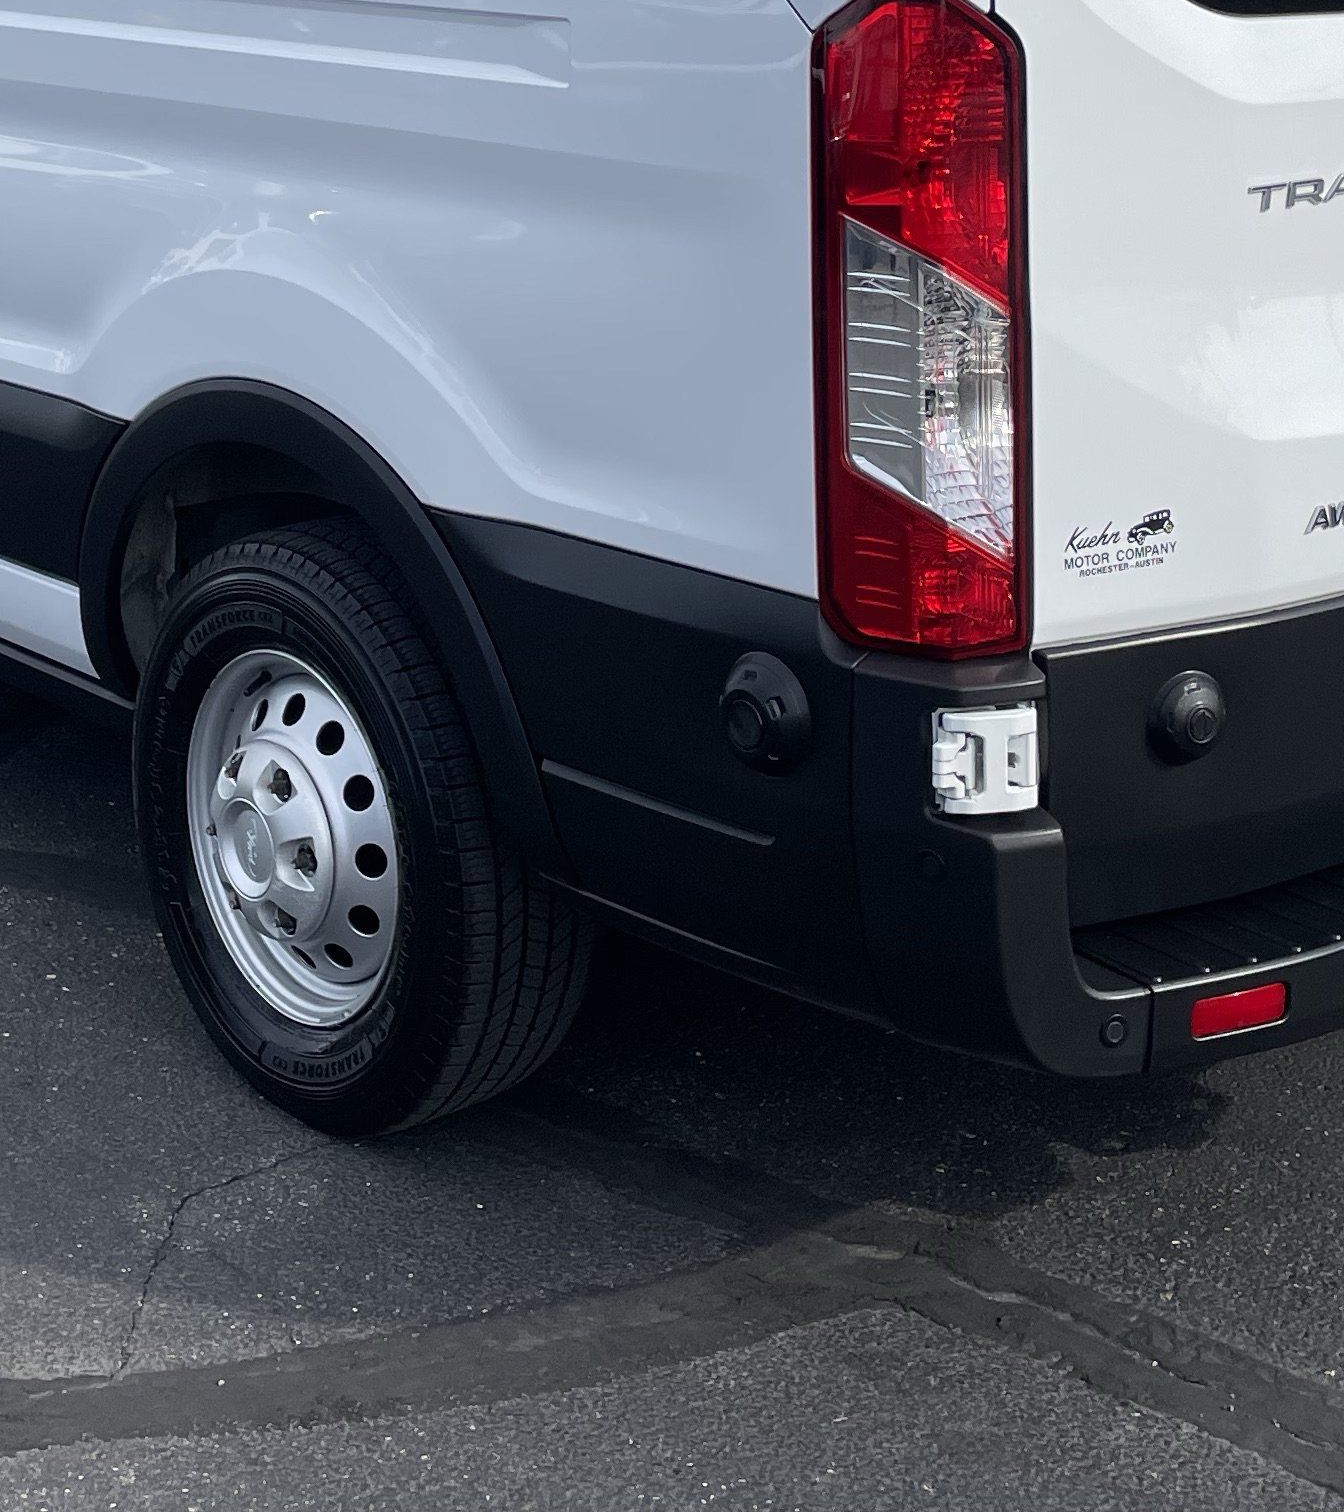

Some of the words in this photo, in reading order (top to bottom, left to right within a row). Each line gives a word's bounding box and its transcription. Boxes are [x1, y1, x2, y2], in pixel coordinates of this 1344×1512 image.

[1064, 520, 1121, 554] Kuehn
[1064, 552, 1110, 571] MOTOR
[1116, 541, 1177, 563] COMPANY
